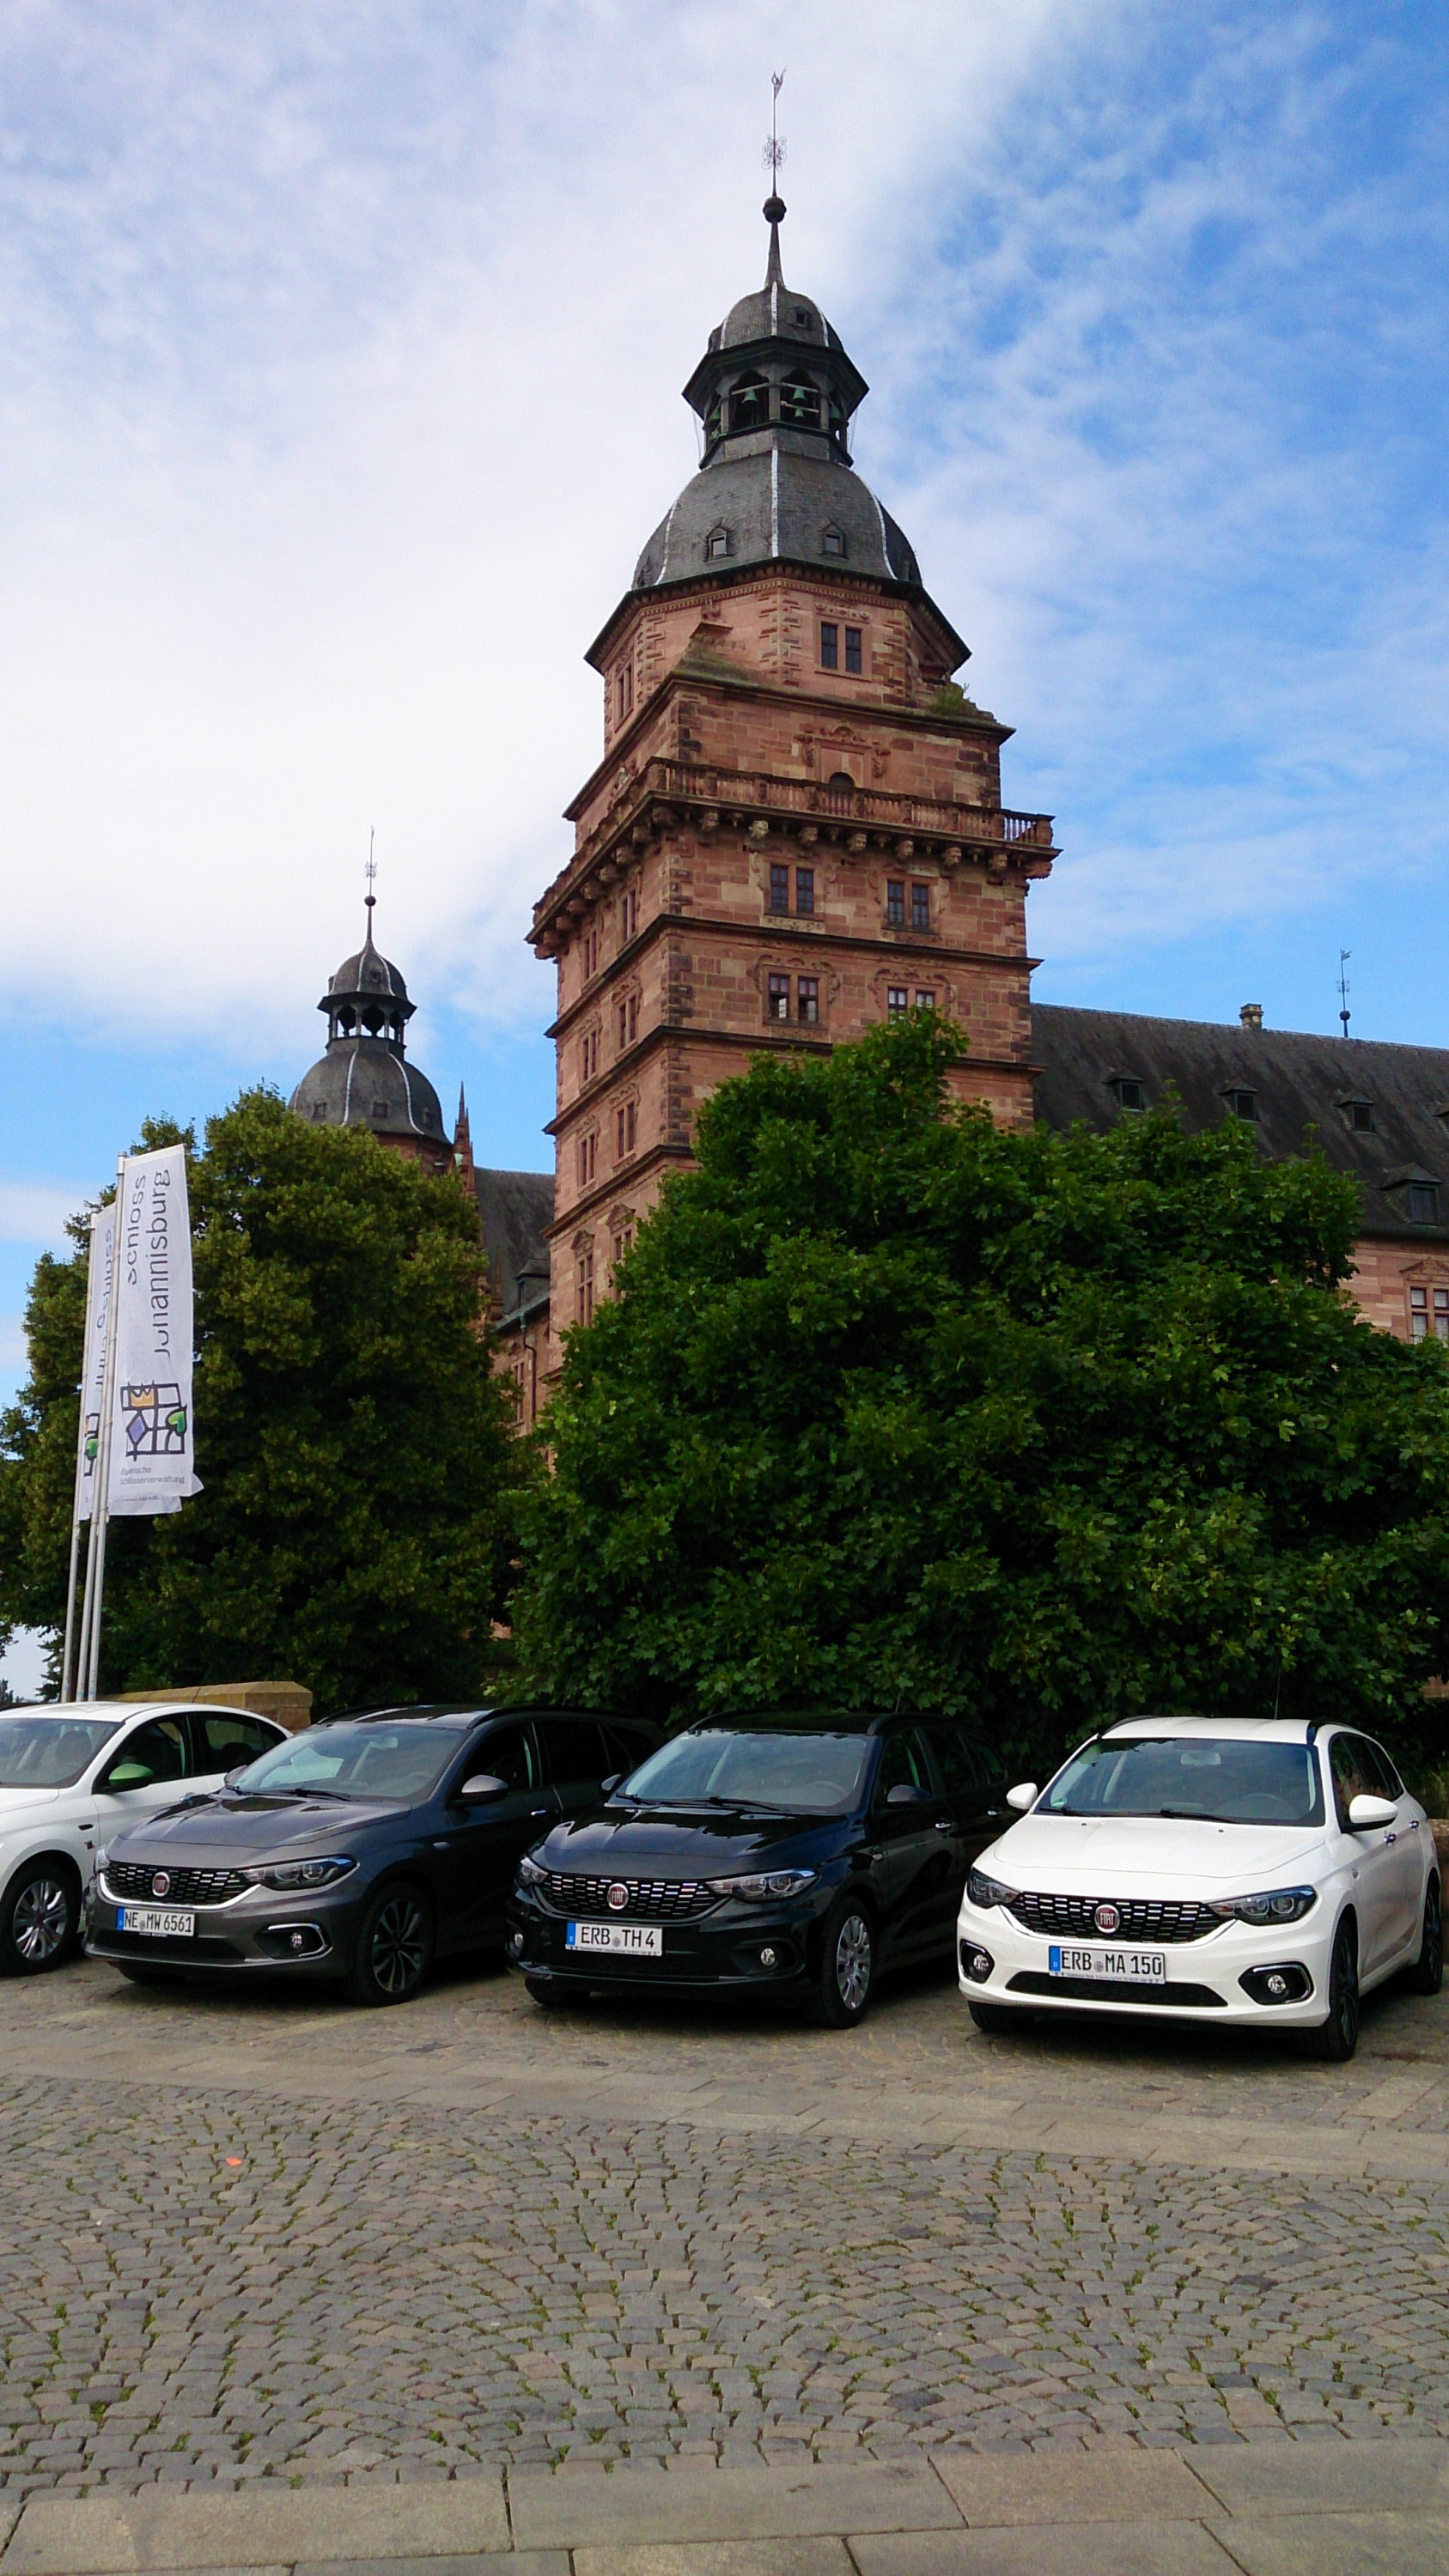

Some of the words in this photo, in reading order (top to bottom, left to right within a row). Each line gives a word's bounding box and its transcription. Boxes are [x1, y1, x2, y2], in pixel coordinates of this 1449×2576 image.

[612, 1891, 624, 1903] FIAT
[125, 1911, 138, 1929] NE
[146, 1913, 161, 1930] MW
[164, 1914, 192, 1933] 6561
[1099, 1912, 1115, 1926] FIAT
[581, 1926, 611, 1945] ERB
[622, 1929, 642, 1947] TH
[645, 1930, 654, 1948] 4
[1061, 1950, 1092, 1971] ERB
[1105, 1953, 1126, 1973] MA
[1130, 1955, 1162, 1976] 150
